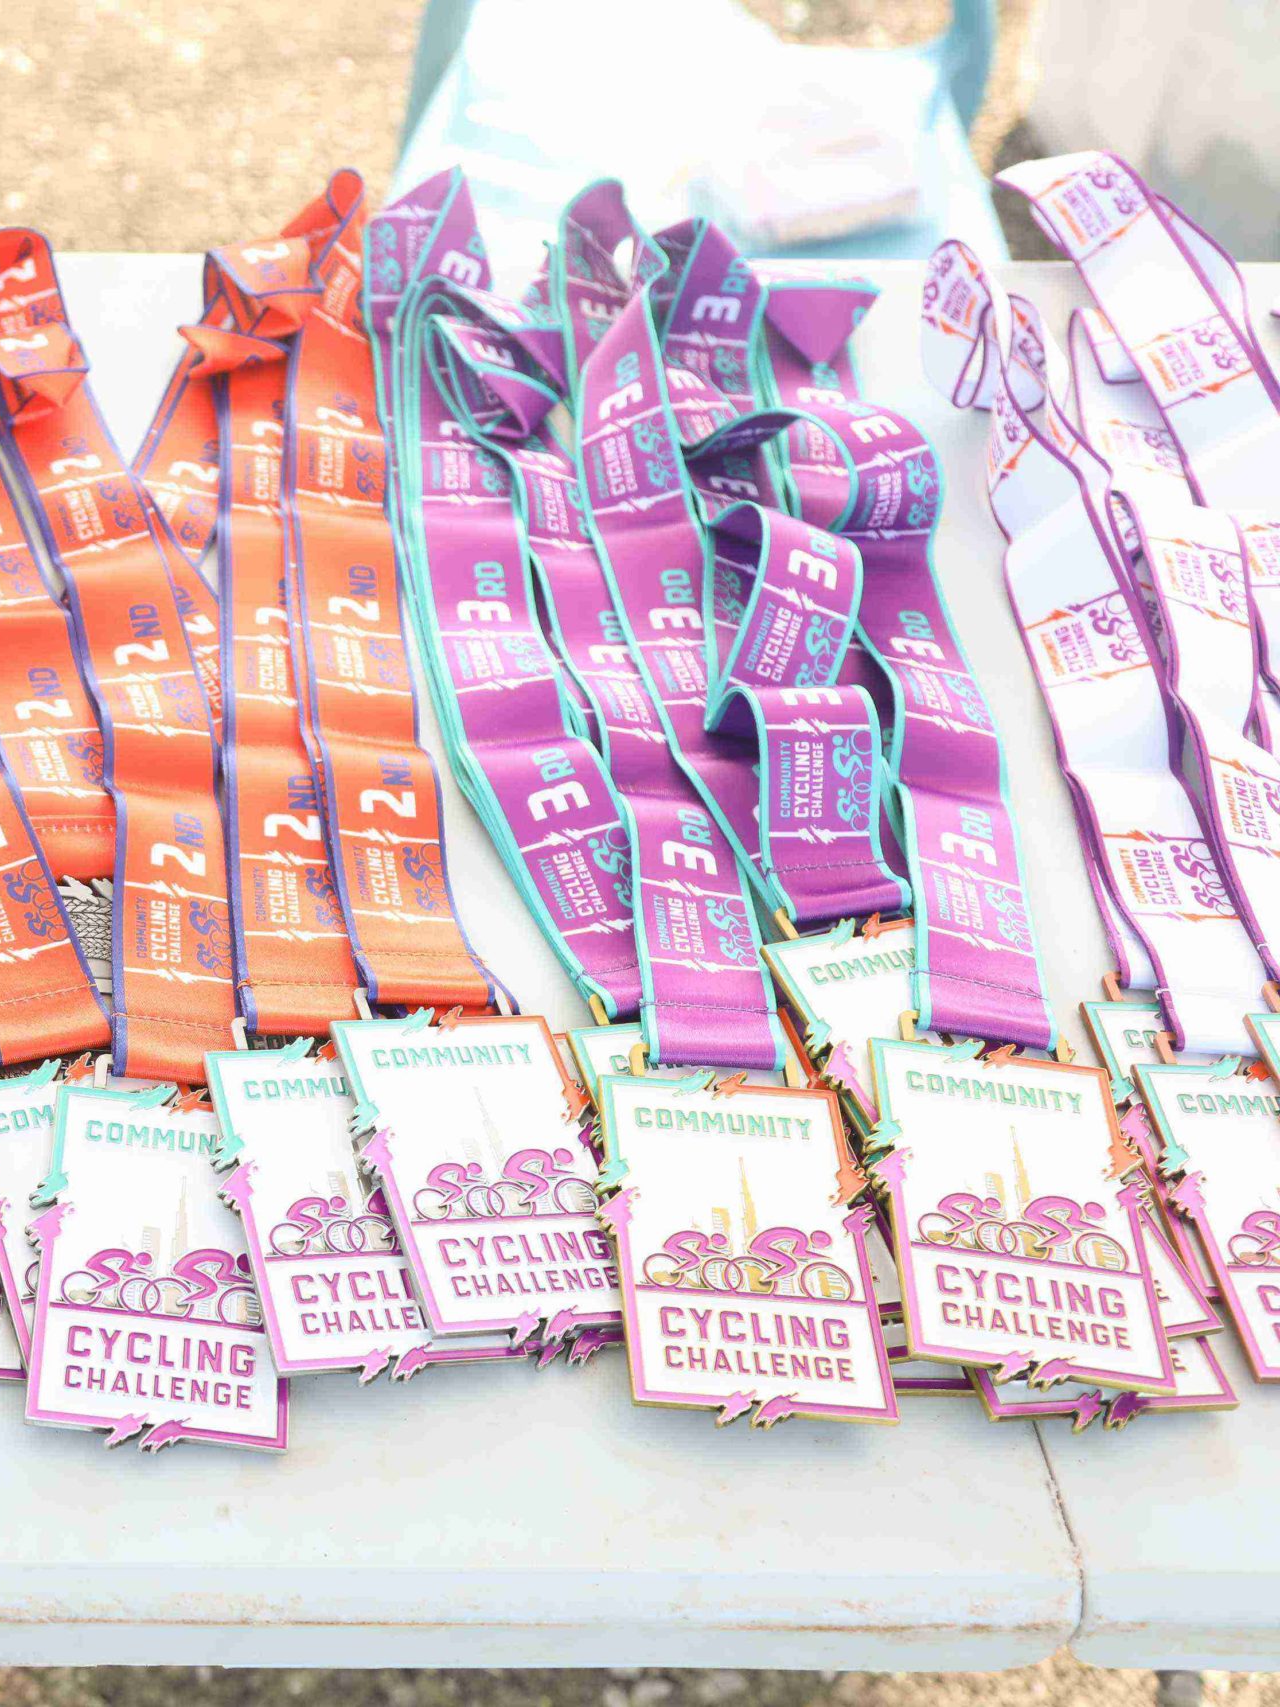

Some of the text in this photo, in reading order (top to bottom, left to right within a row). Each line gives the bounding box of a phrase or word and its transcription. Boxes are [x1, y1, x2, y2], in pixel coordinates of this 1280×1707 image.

[175, 587, 217, 637] 2ND
[328, 565, 380, 622] 2ND
[457, 561, 511, 622] 3RD
[649, 568, 703, 630] 3RD
[114, 604, 170, 666] 2ND
[745, 601, 776, 670] COMMUNITY
[756, 607, 792, 677] CYCLING
[771, 613, 804, 681] CHALLENGE
[890, 610, 945, 660] 3RD
[15, 667, 72, 720] 2ND
[264, 774, 320, 841] 2ND
[360, 755, 416, 819] 2ND
[528, 747, 590, 821] 3RD
[780, 742, 792, 817] COMMUNITY
[795, 742, 810, 818] CYCLING
[811, 742, 824, 817] CHALLENGE
[1223, 773, 1243, 833] COMMUNITY
[1234, 777, 1258, 837] CYCLING
[941, 807, 997, 866] 3RD
[1248, 783, 1271, 840] CHALLENGE
[151, 813, 206, 877] 2ND
[662, 809, 718, 876] 3RD
[255, 867, 266, 922] COMMUNITY
[269, 869, 287, 924] CYCLING
[284, 872, 302, 924] CHALLENGE
[352, 845, 369, 900] COMMUNITY
[365, 848, 388, 905] CYCLING
[382, 851, 401, 906] CHALLENGE
[538, 857, 575, 919] COMMUNITY
[553, 853, 594, 916] CYCLING
[570, 850, 607, 913] CHALLENGE
[1119, 848, 1147, 904] COMMUNITY
[1134, 849, 1168, 905] CYCLING
[1152, 851, 1181, 905] CHALLENGE
[136, 897, 147, 958] COMMUNITY
[151, 900, 167, 961] CYCLING
[166, 903, 182, 963] CHALLENGE
[653, 895, 671, 950] COMMUNITY
[670, 898, 690, 952] CYCLING
[684, 901, 706, 954] CHALLENGE
[808, 948, 915, 986] COMMUN
[372, 1044, 532, 1070] COMMUNITY
[242, 1076, 349, 1099] COMMU
[906, 1070, 1083, 1115] COMMUNITY
[1182, 1094, 1280, 1115] COMMU
[84, 1119, 217, 1154] COMMUN
[634, 1107, 811, 1140] COMMUNITY
[438, 1229, 610, 1268] CYCLING
[291, 1270, 415, 1304] CYCLI
[451, 1264, 620, 1298] CHALLENGE
[936, 1264, 1128, 1320] CYCLING
[300, 1308, 420, 1336] CHALLE
[659, 1306, 851, 1352] CYCLING
[942, 1301, 1133, 1352] CHALLENGE
[65, 1325, 256, 1378] CYCLING
[665, 1345, 856, 1382] CHALLENGE
[64, 1364, 252, 1410] CHALLENGE
